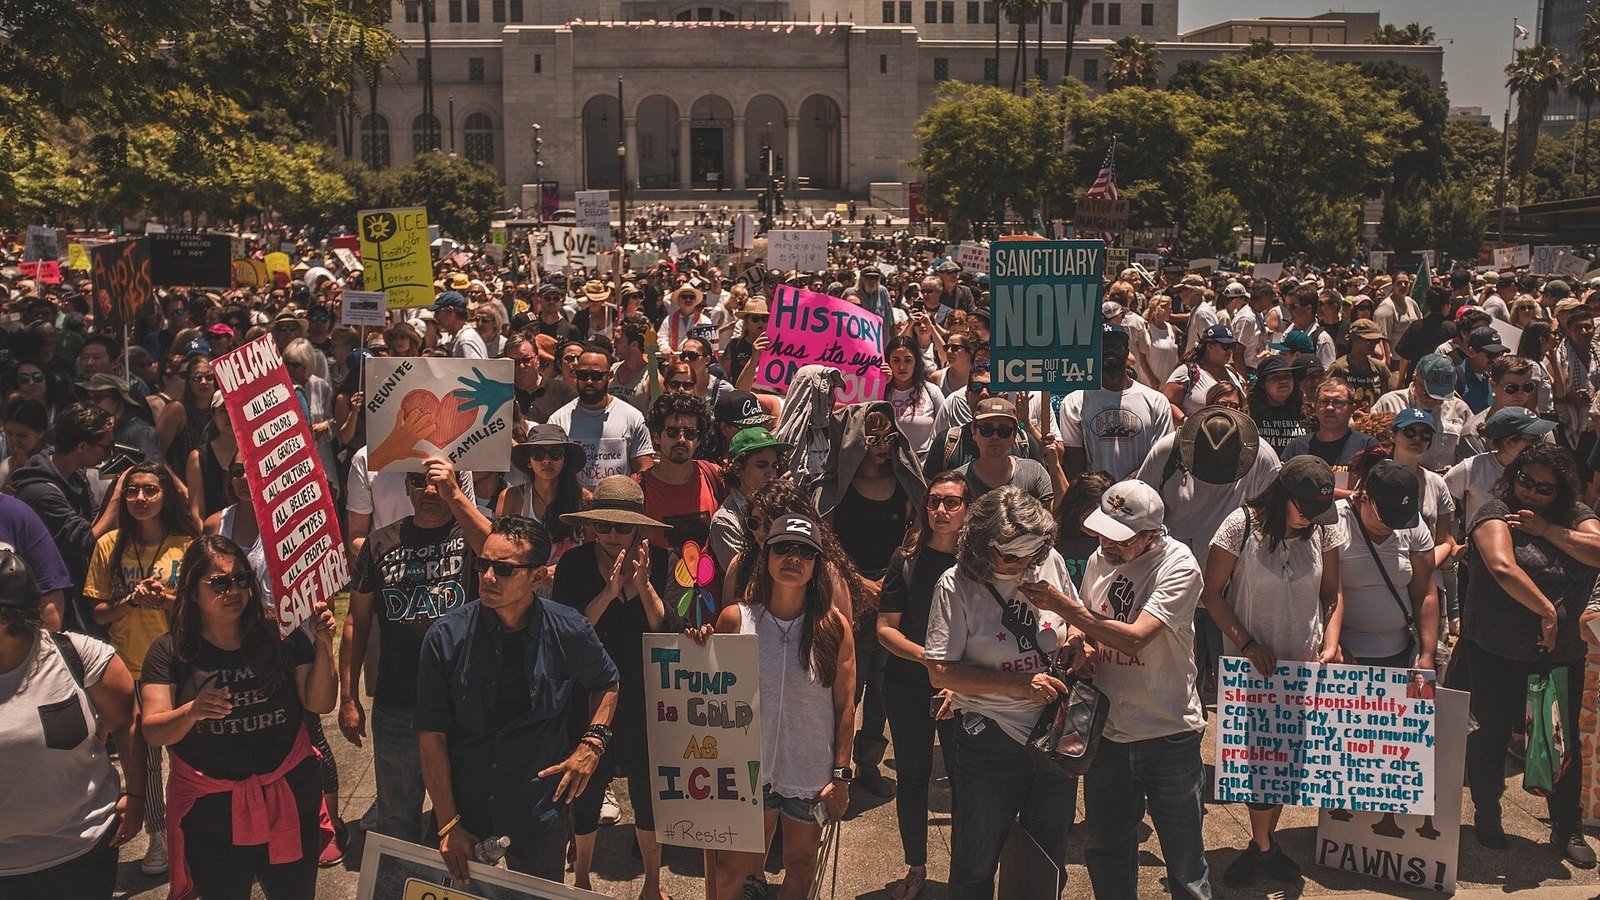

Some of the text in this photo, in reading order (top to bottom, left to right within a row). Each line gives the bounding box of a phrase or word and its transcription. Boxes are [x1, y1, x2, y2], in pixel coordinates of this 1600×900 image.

[549, 230, 597, 257] LOVE
[995, 248, 1098, 277] SANCTUARY
[775, 288, 883, 353] HISTORY
[995, 283, 1098, 347] NOW
[214, 338, 284, 394] WELCOME
[765, 333, 883, 376] has its eyes
[997, 359, 1044, 383] ICE
[1044, 358, 1060, 371] OUT
[1046, 371, 1058, 383] OF
[366, 360, 413, 414] REUNITE
[251, 388, 279, 418] ALL AGES
[257, 414, 292, 445] ALL COLORS
[1262, 419, 1300, 428] EL PUEBLO
[448, 417, 506, 464] FAMILIES
[263, 437, 301, 476] ALL GENDERS
[268, 460, 312, 500] ALL CULTURES
[275, 484, 316, 527] ALL BELIEFS
[280, 510, 325, 561] ALL TYPES
[383, 537, 465, 563] OUT OF THIS
[287, 537, 329, 584] ALL PEOPLE
[279, 543, 352, 637] SAFE HERE
[381, 580, 466, 621] DAD
[1222, 673, 1386, 698] which we need to
[1296, 665, 1312, 678] in
[1317, 668, 1328, 679] a
[1332, 667, 1386, 683] world
[687, 697, 754, 730] COLD
[1224, 688, 1277, 704] share
[1285, 693, 1408, 718] responsibility
[1224, 704, 1268, 722] easy
[1273, 704, 1293, 720] to
[1367, 713, 1398, 727] not
[1402, 717, 1430, 734] my
[1276, 720, 1305, 735] not
[1311, 724, 1338, 741] my
[682, 734, 719, 760] AS
[1222, 731, 1251, 746] not
[1256, 735, 1283, 752] my
[1347, 740, 1375, 754] not
[1382, 744, 1410, 761] my
[1290, 749, 1332, 765] Then
[1338, 753, 1386, 769] there
[1389, 759, 1421, 772] are
[1218, 774, 1254, 790] and
[1335, 780, 1344, 796] I
[1347, 785, 1425, 802] consider
[1221, 760, 1424, 787] those who see the need
[1218, 786, 1260, 803] those
[1263, 792, 1315, 806] people
[1320, 796, 1347, 810] my
[664, 820, 738, 845] #Resist
[1319, 838, 1447, 893] PAWNS!
